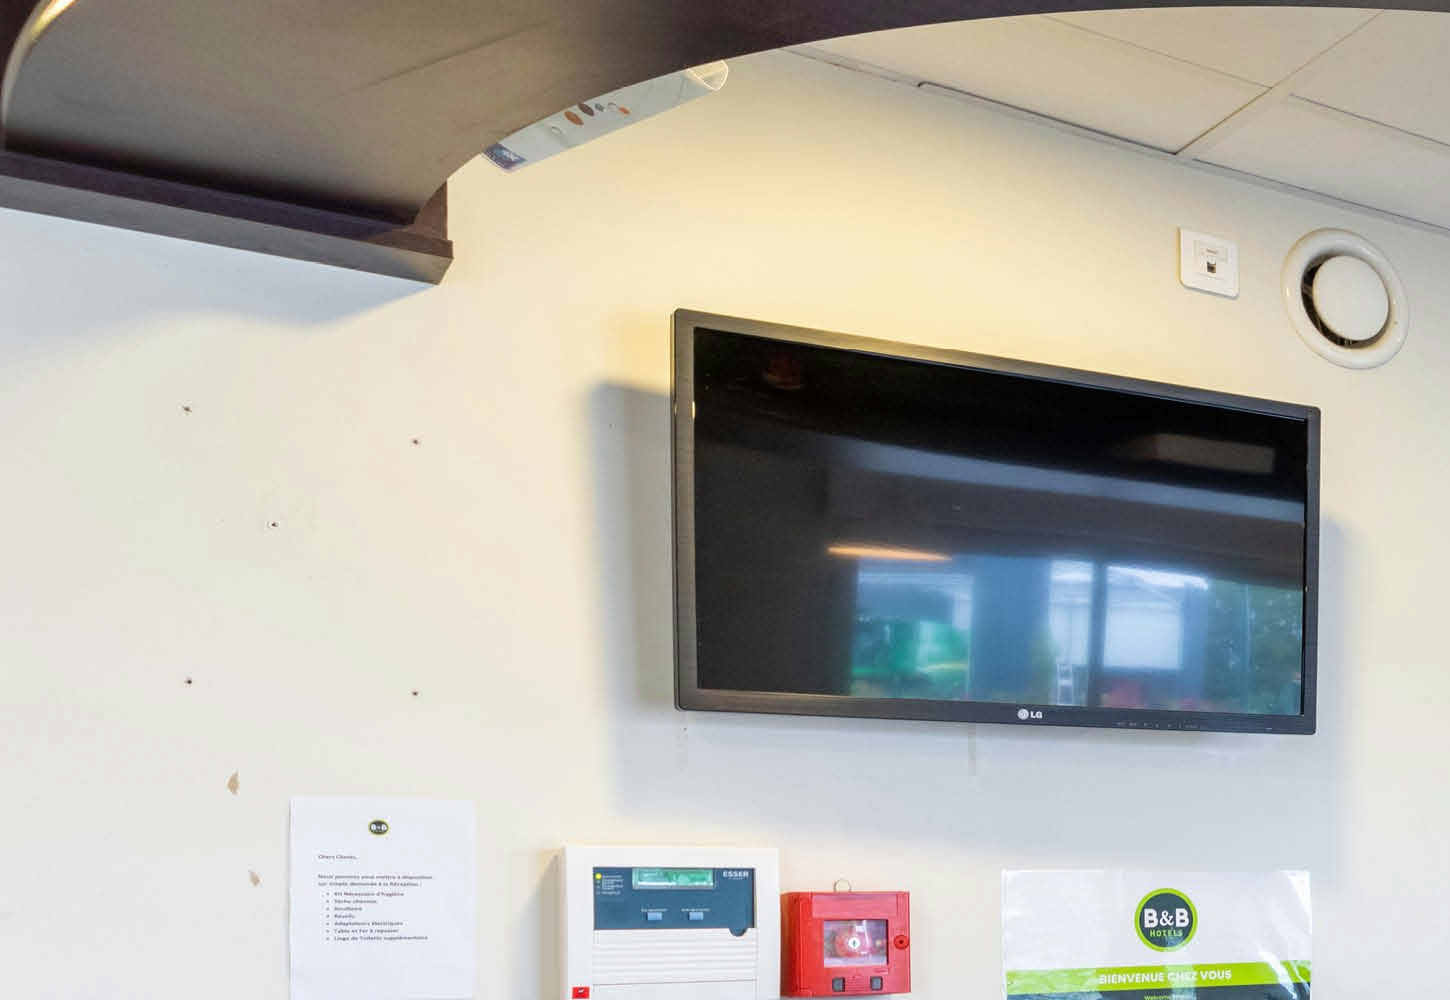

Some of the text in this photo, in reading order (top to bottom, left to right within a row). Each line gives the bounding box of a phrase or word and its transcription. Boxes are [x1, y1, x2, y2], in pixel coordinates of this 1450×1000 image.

[1030, 710, 1043, 719] LG
[723, 870, 749, 878] ESSER
[1144, 908, 1190, 928] B&B
[1149, 929, 1183, 937] HOTELS
[1099, 969, 1232, 984] BIENVENUE CHEZ VOUS
